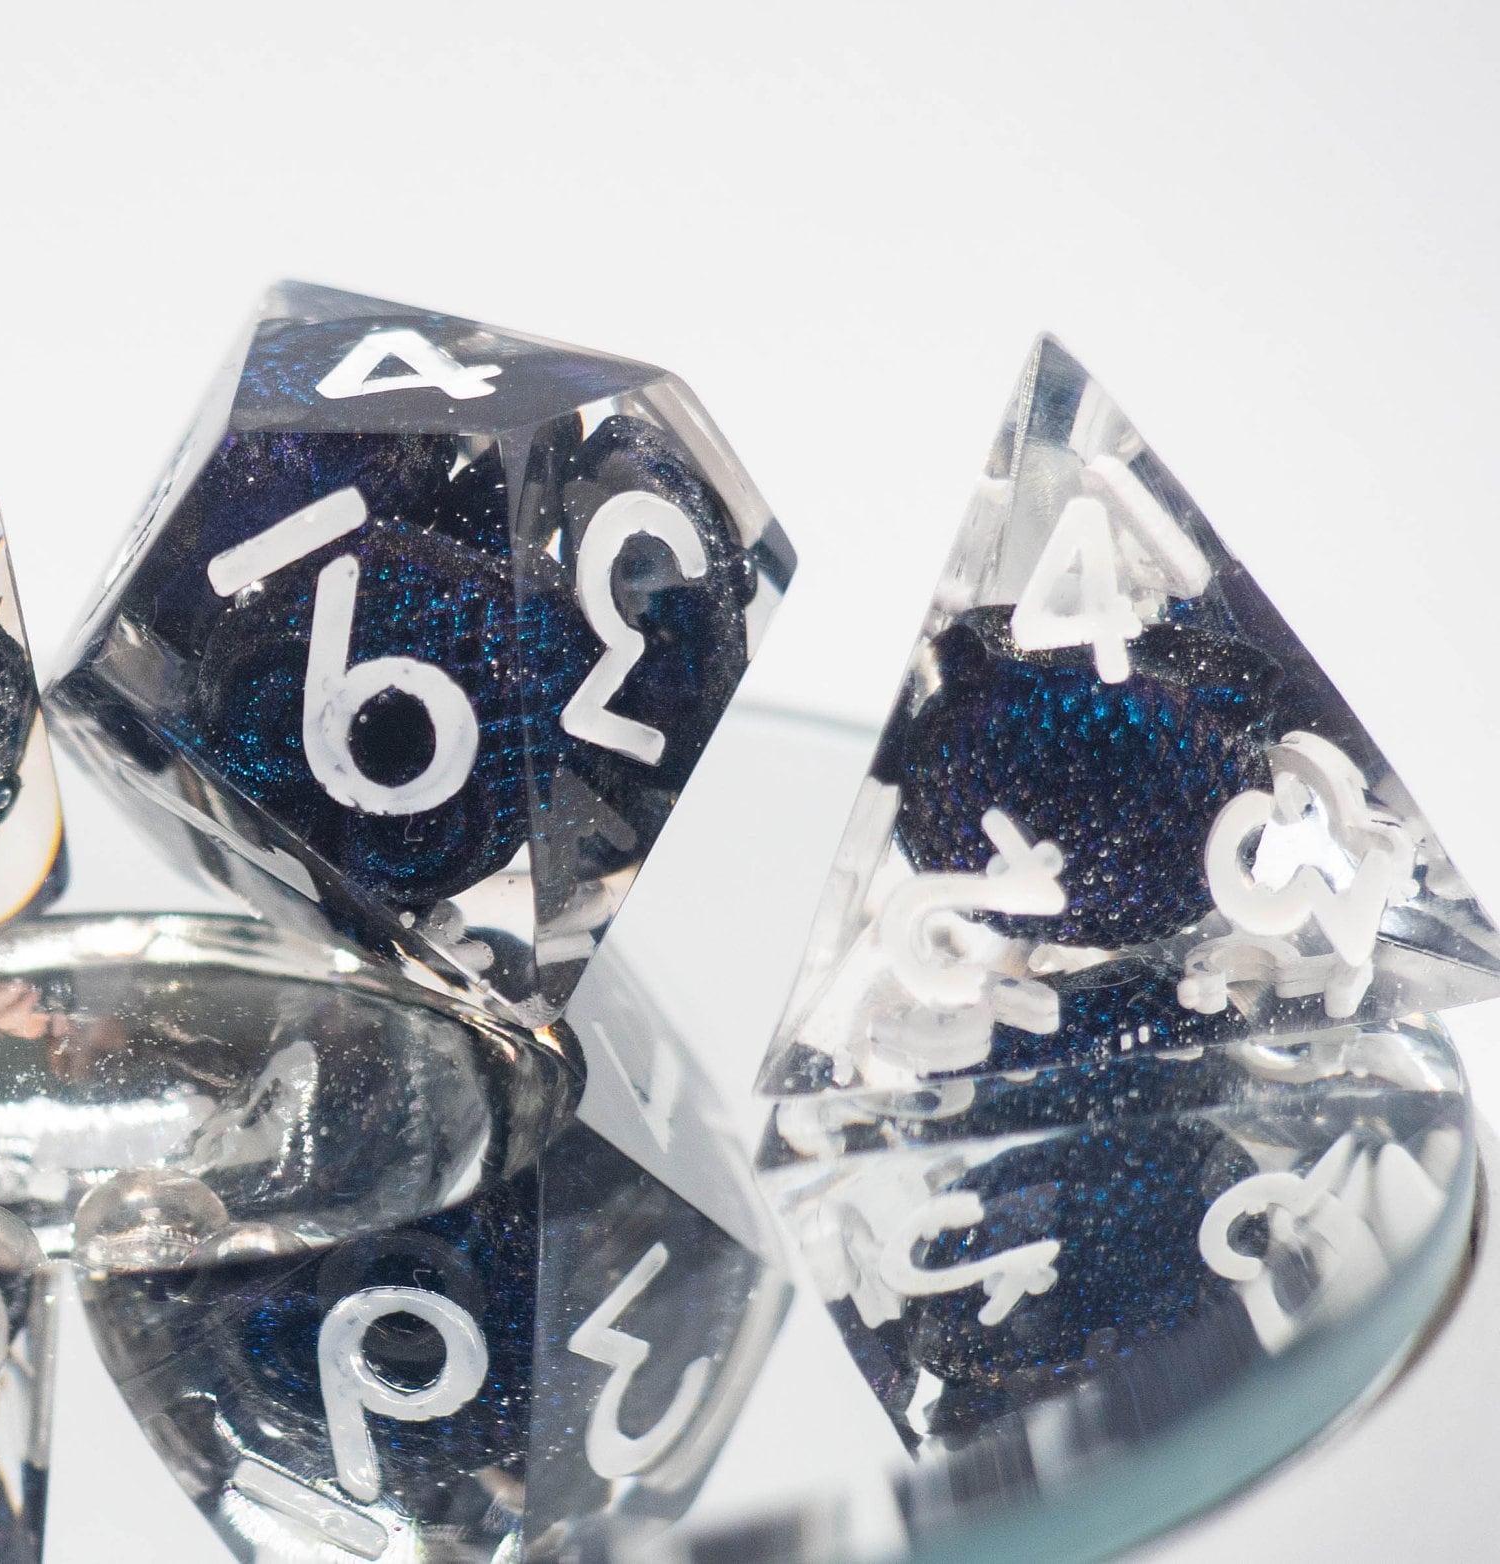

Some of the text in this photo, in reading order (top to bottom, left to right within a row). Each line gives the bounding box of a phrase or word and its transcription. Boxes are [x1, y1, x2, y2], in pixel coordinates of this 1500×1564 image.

[315, 328, 503, 401] 4
[561, 489, 707, 768] 3
[1011, 496, 1144, 685] 4
